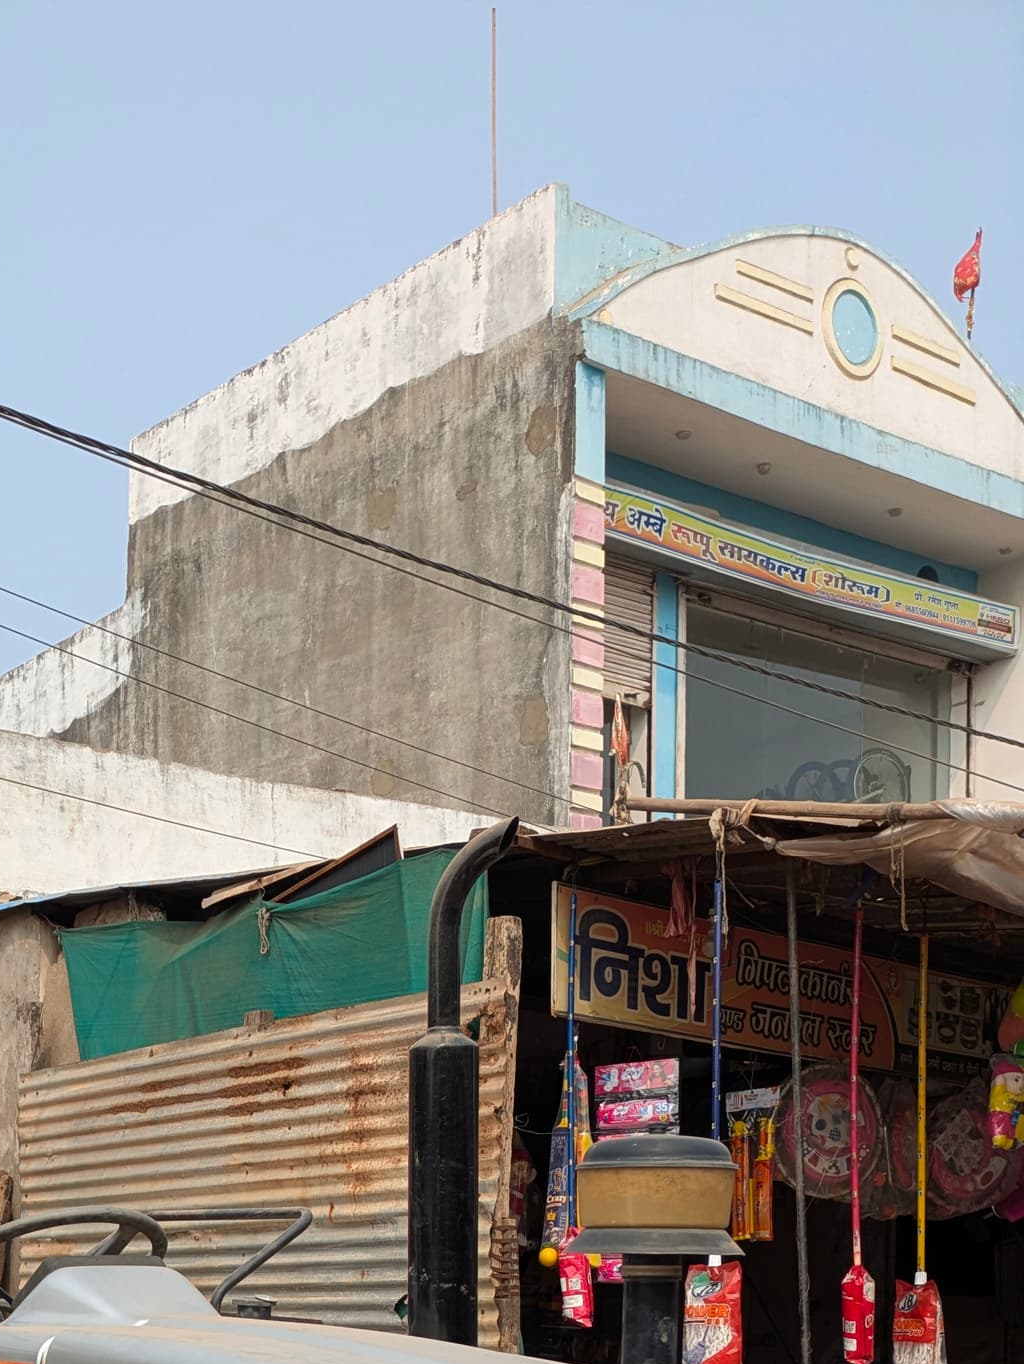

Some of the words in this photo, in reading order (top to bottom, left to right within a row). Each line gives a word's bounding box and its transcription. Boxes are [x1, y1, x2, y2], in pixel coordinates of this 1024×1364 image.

[626, 506, 667, 538] अम्बे
[718, 539, 808, 583] सायकल्स
[574, 907, 712, 1023] निशा
